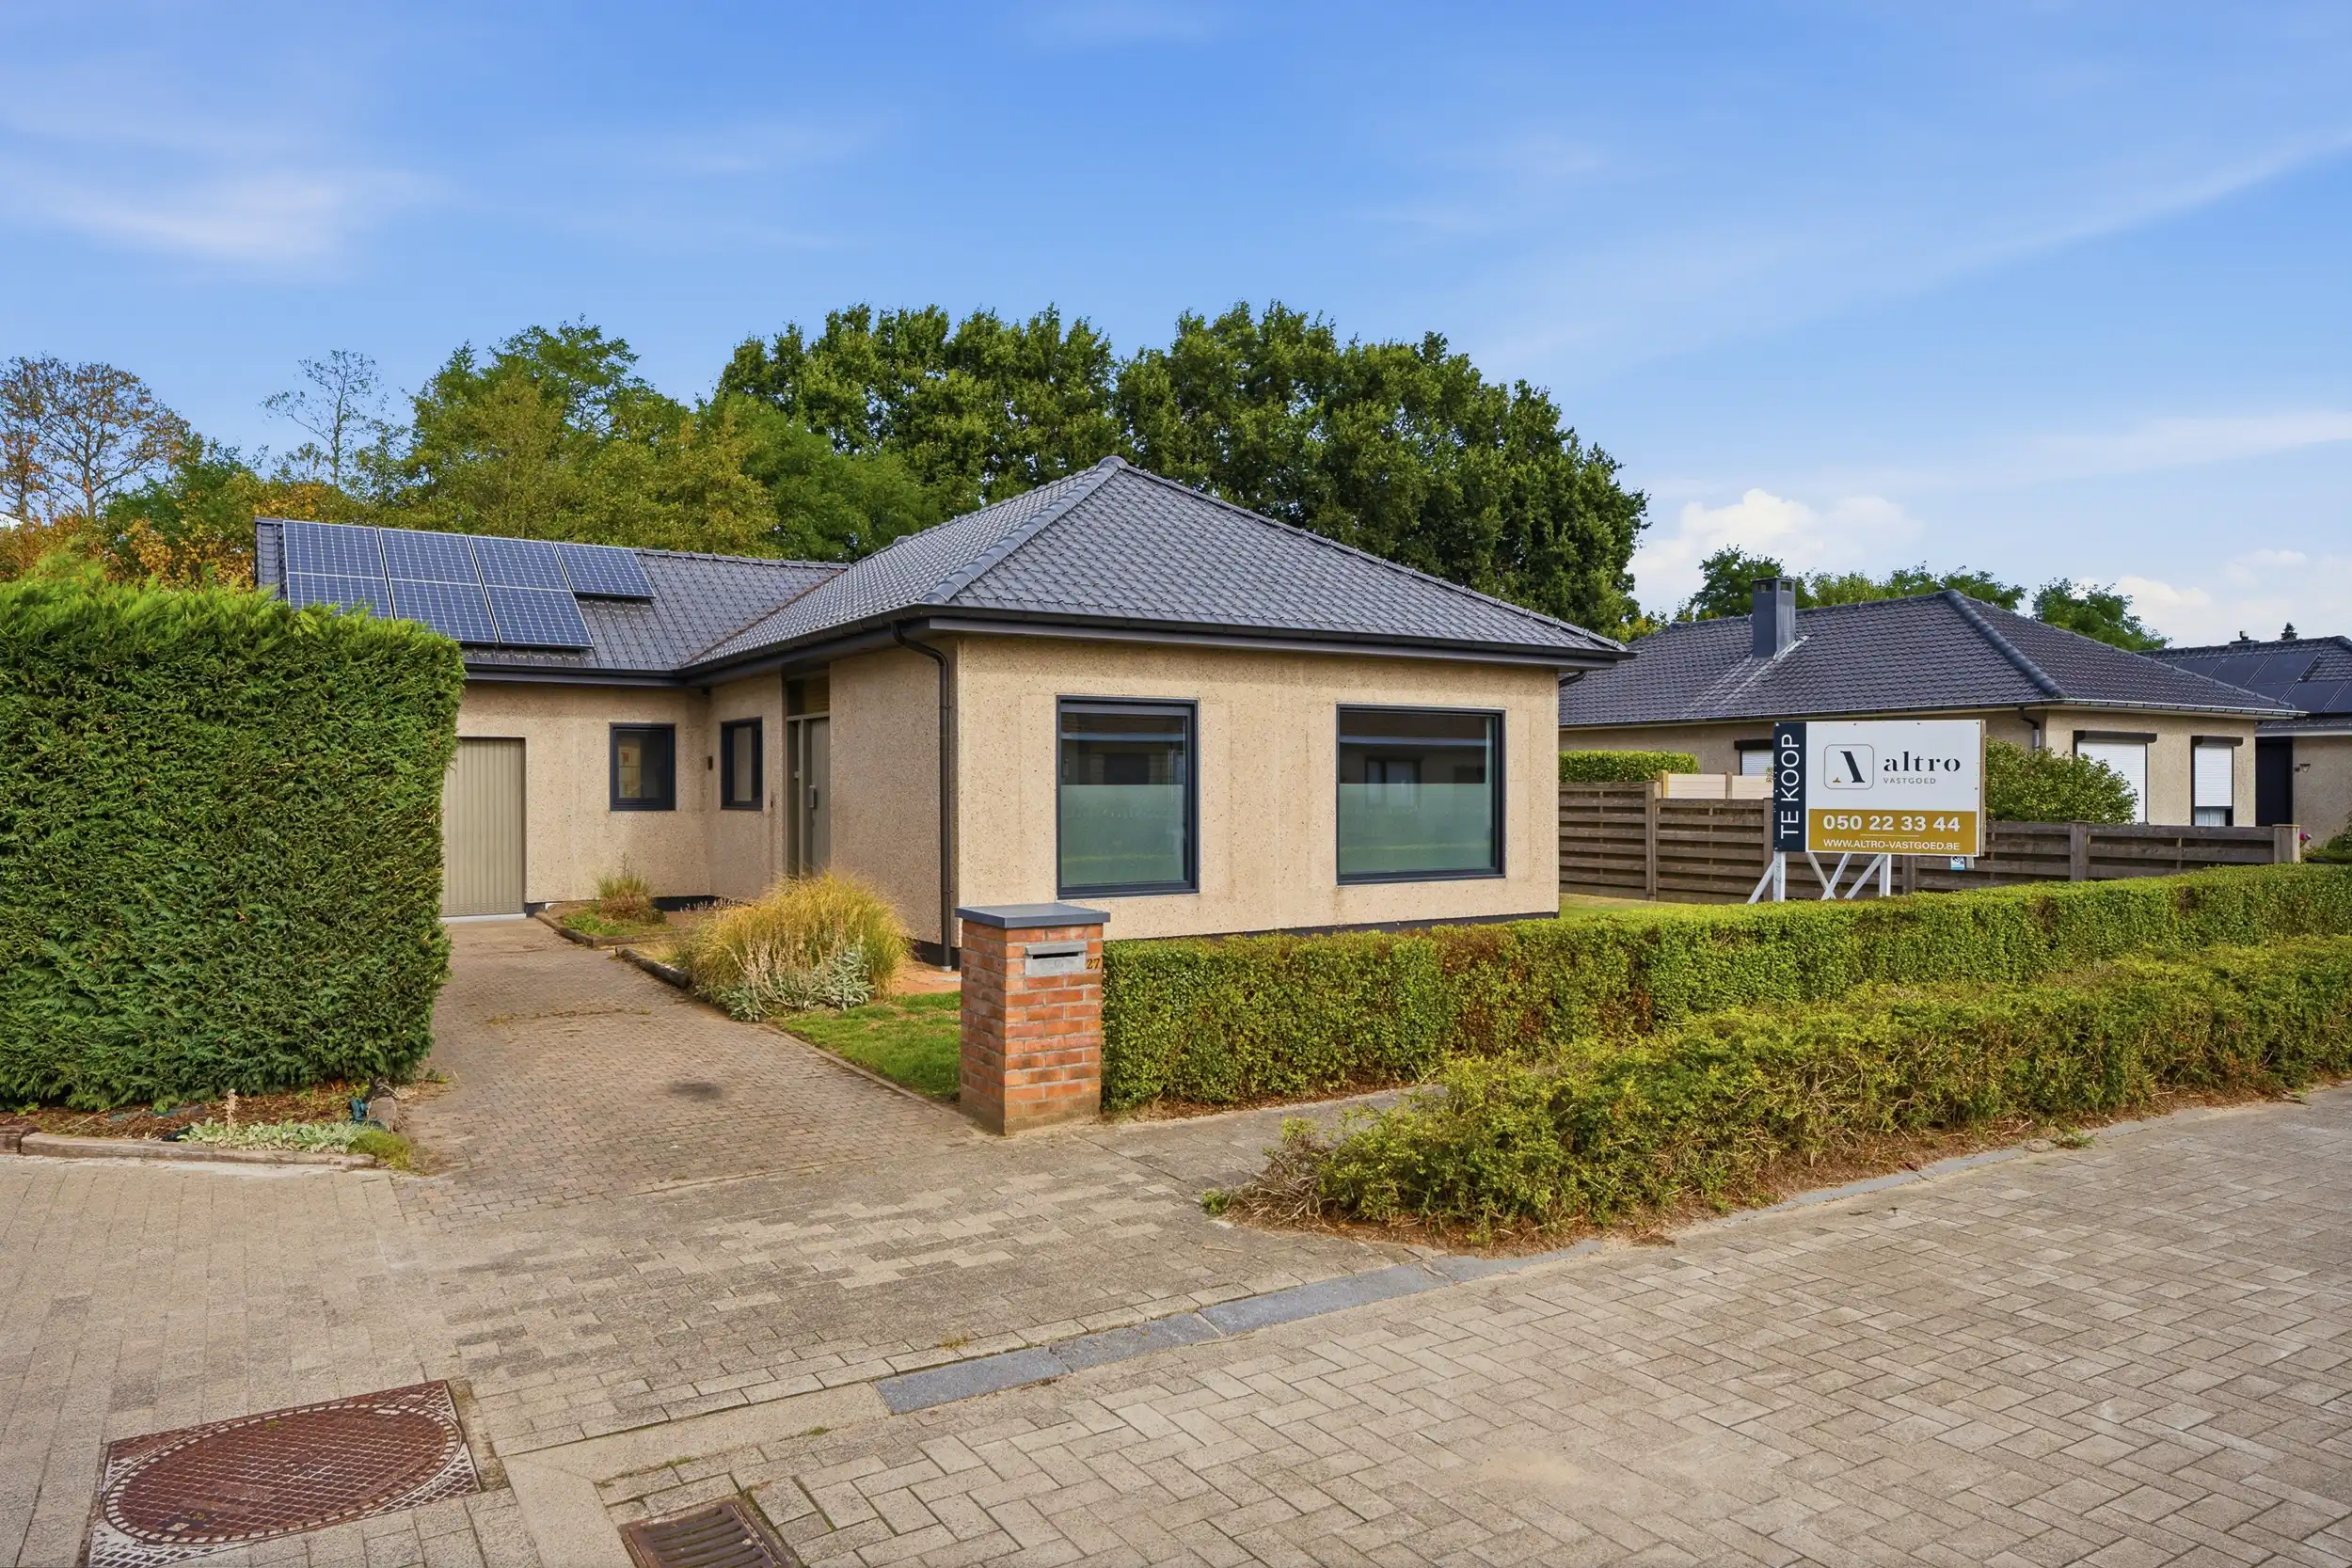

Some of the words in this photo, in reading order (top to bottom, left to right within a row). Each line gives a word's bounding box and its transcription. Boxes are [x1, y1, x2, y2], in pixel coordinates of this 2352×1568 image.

[1780, 734, 1800, 801] KOOP
[1883, 751, 1961, 772] altro
[1780, 811, 1800, 840] TE
[1822, 815, 1862, 831] 050
[1868, 816, 1894, 832] 22
[1899, 816, 1927, 832] 33
[1932, 816, 1961, 832] 44
[1822, 838, 1961, 851] WWW.ALTRO-VASTGOED.BE
[1086, 958, 1101, 970] 27
